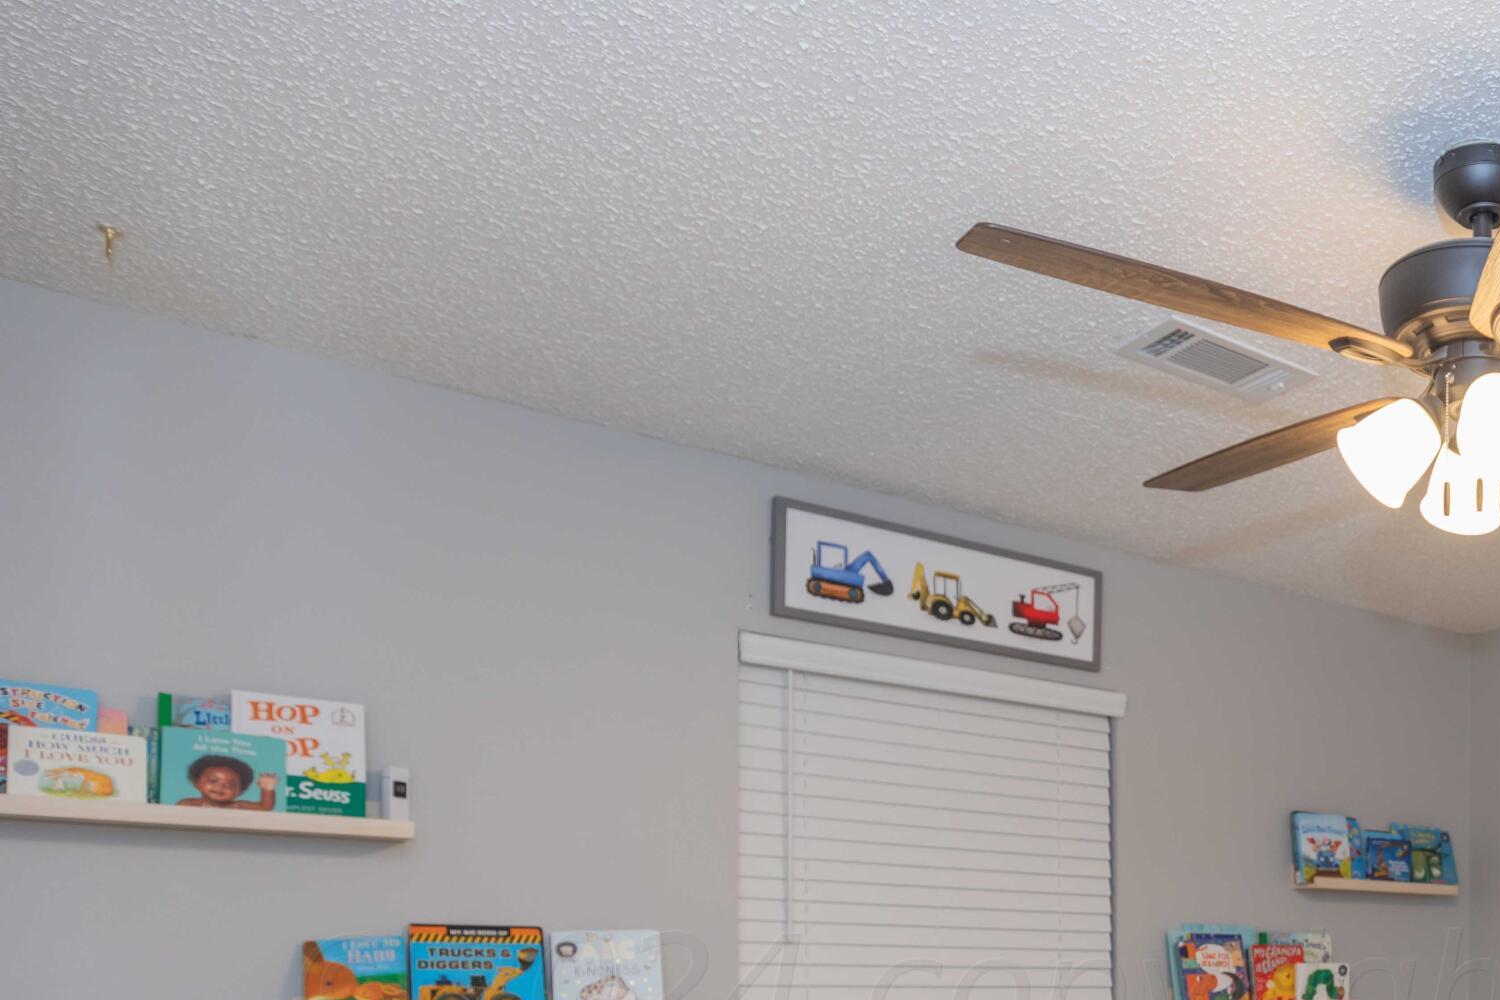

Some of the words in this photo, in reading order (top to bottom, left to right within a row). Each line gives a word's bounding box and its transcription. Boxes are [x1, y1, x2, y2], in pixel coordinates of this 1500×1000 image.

[248, 700, 320, 725] HOP
[271, 725, 294, 735] ON
[39, 750, 89, 763] LOVE
[96, 756, 134, 766] YOU
[299, 781, 351, 804] Seuss
[428, 947, 496, 959] TRUCKS
[500, 947, 512, 959] &
[416, 960, 493, 970] DIGGERS
